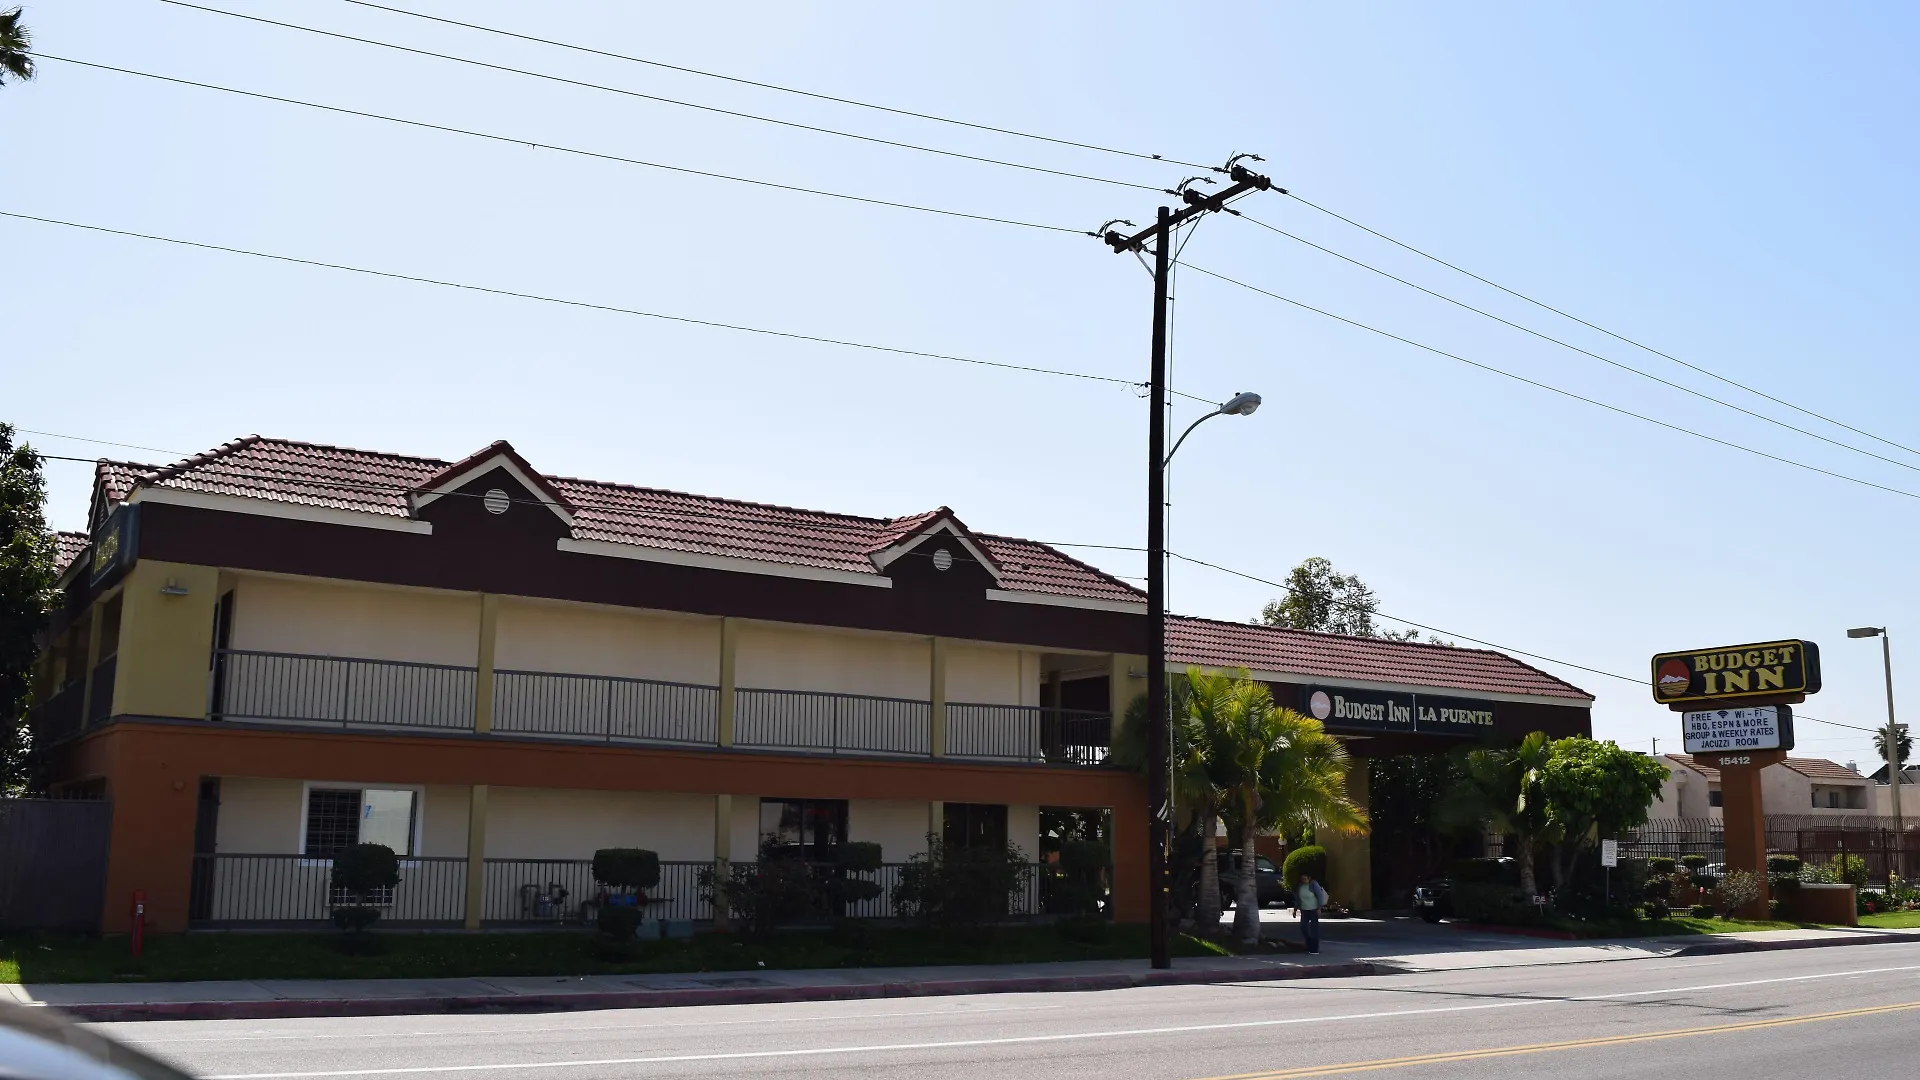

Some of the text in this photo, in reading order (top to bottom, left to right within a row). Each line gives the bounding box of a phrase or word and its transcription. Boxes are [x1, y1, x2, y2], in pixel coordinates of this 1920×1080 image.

[1693, 646, 1795, 672] BUDGET
[1703, 666, 1784, 694] INN
[1334, 695, 1493, 725] BUDGET INN LA PUENTE
[1691, 713, 1712, 721] FREE
[1712, 721, 1734, 729] ESPN
[1736, 720, 1741, 728] &
[1743, 718, 1768, 727] MORE
[1685, 731, 1710, 740] GROUP
[1718, 729, 1748, 738] WEEKLY
[1750, 728, 1774, 736] RATES
[1701, 738, 1759, 748] JACUZZI ROOM
[1719, 756, 1751, 765] 15412
